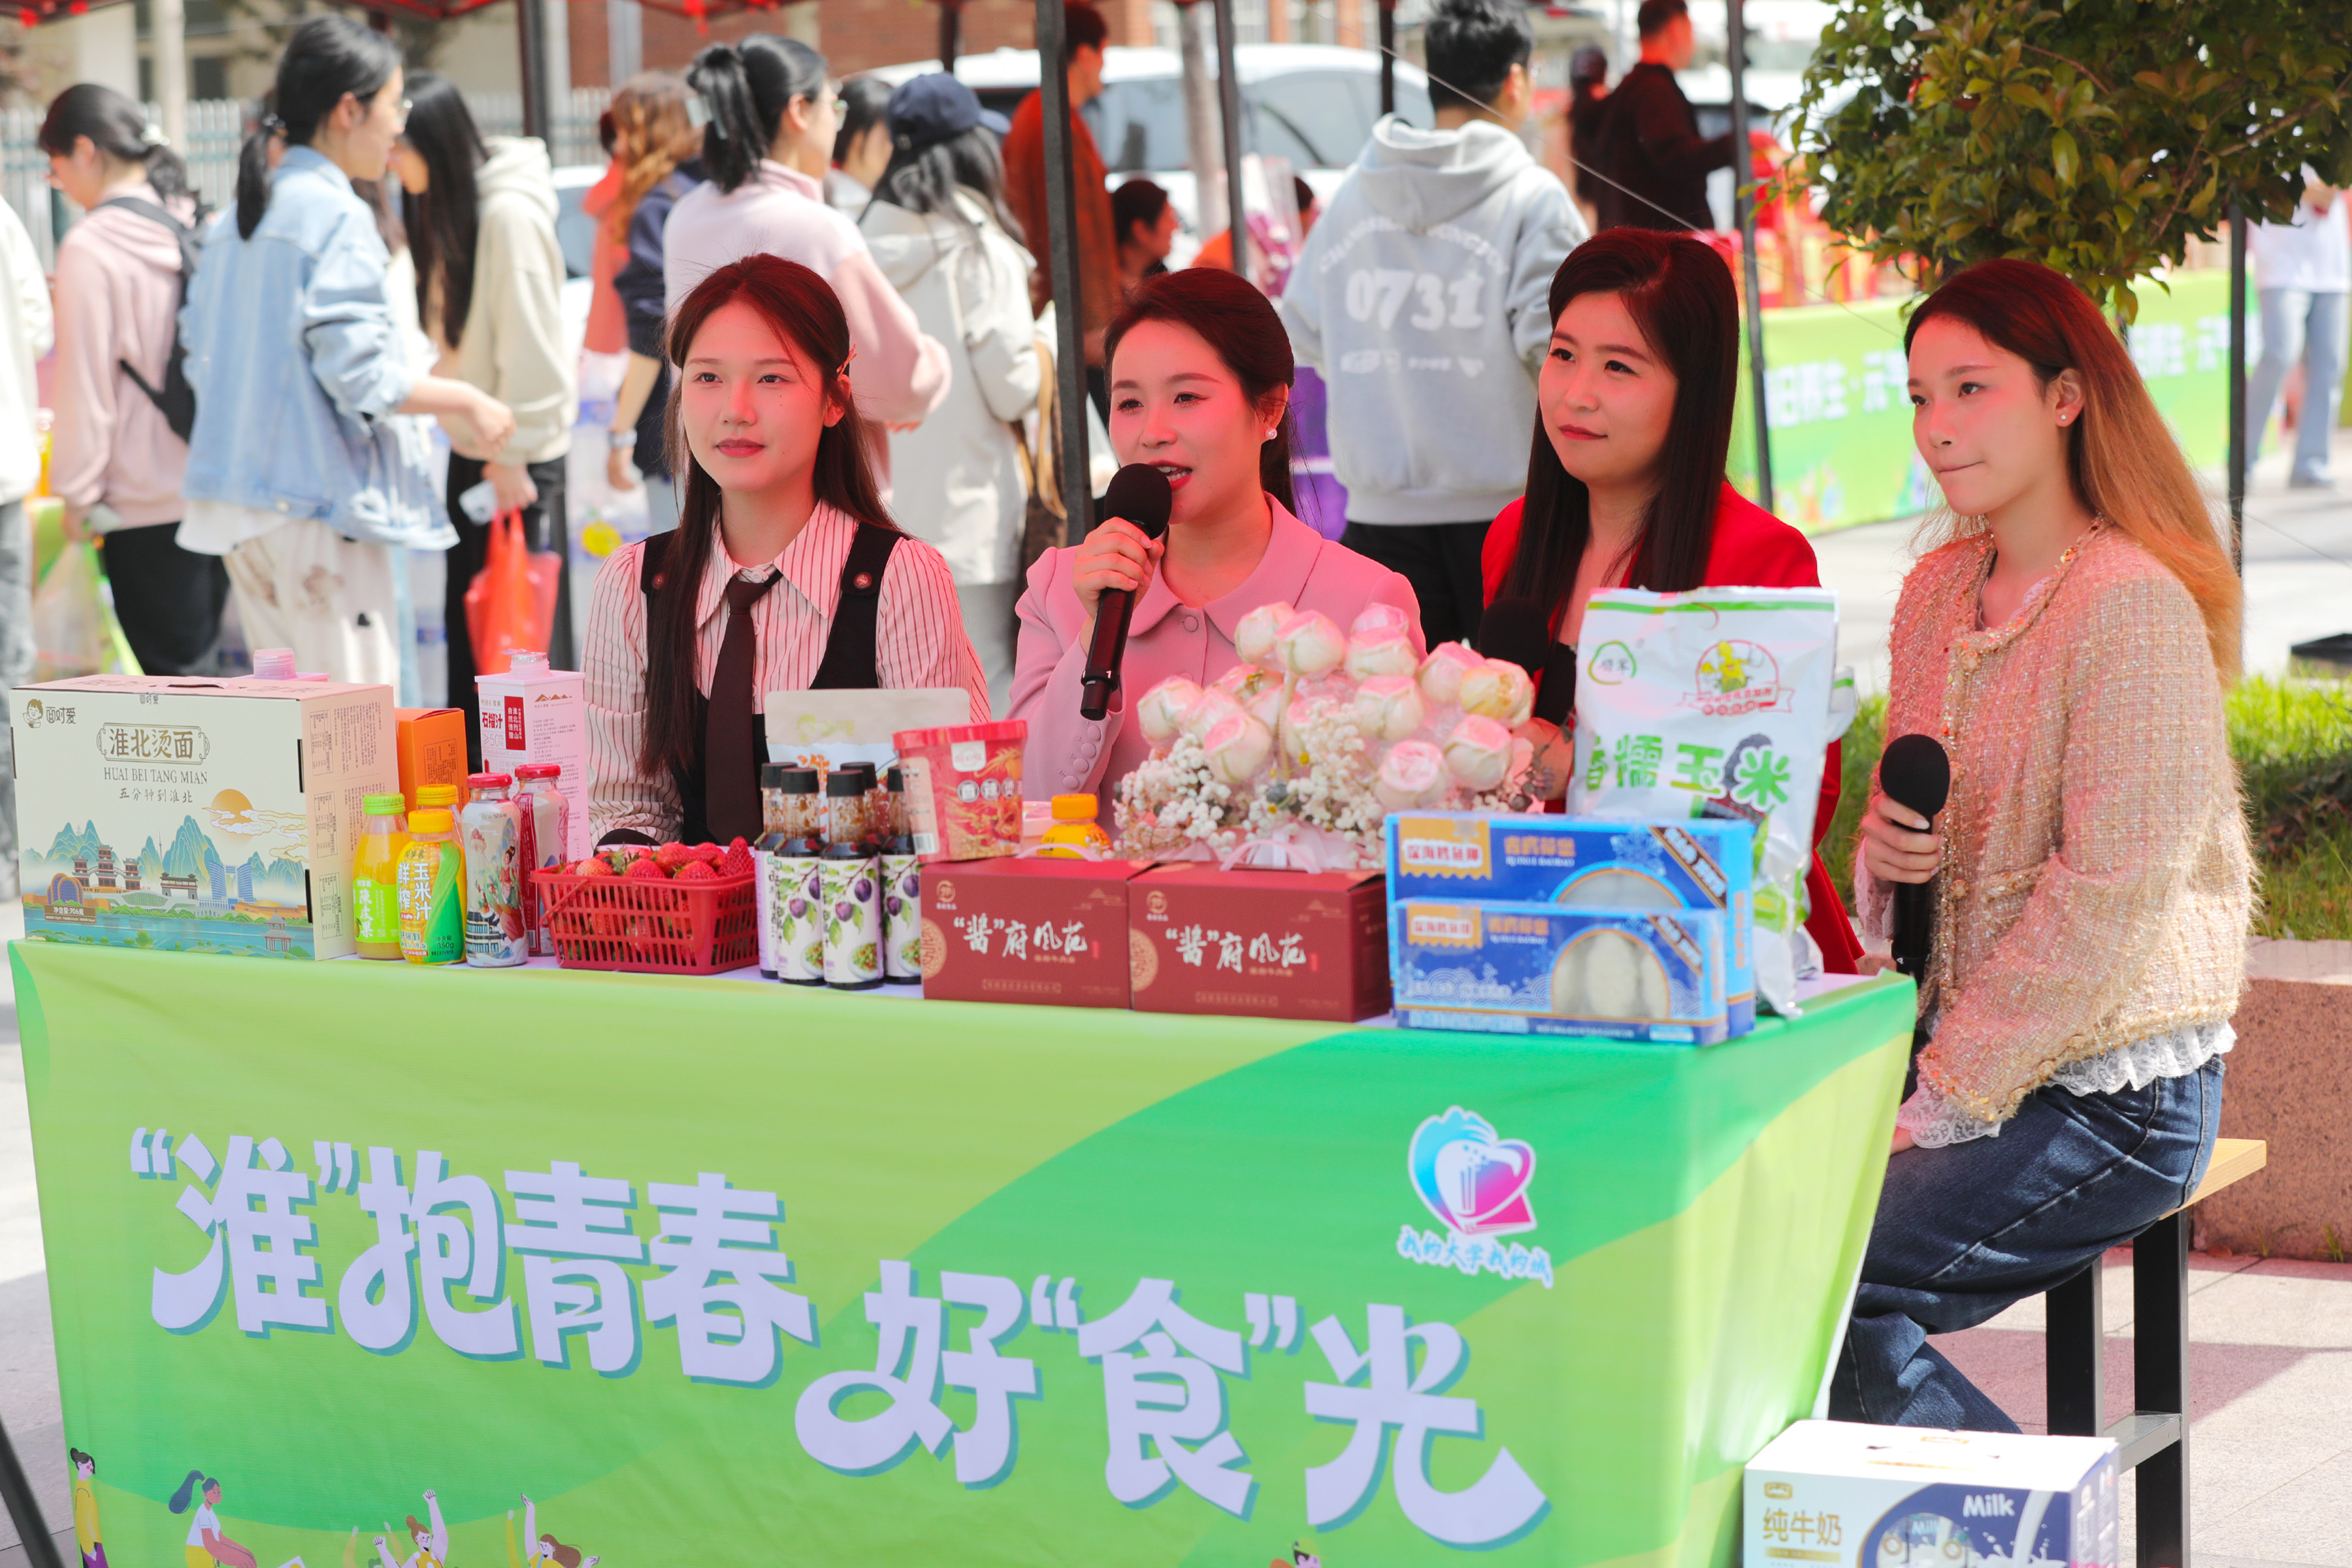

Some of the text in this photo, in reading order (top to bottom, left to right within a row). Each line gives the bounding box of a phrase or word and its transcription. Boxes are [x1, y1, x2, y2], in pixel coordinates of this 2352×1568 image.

[1345, 268, 1486, 331] 0731
[46, 707, 76, 725] 面对爱
[482, 712, 503, 729] 石榴汁
[109, 728, 194, 760] 淮北烫面
[104, 768, 208, 785] HUAI BEI TANG MIAN
[119, 788, 193, 804] 五分钟到淮北
[398, 862, 411, 910] 鲜榨
[414, 862, 433, 921] 玉米汁
[130, 1127, 817, 1386] “淮”抱青春
[1399, 1226, 1553, 1288] 我的大学我的城
[795, 1259, 1550, 1547] 好“食”光
[1962, 1493, 2016, 1518] Milk
[1763, 1507, 1842, 1546] 纯牛奶
